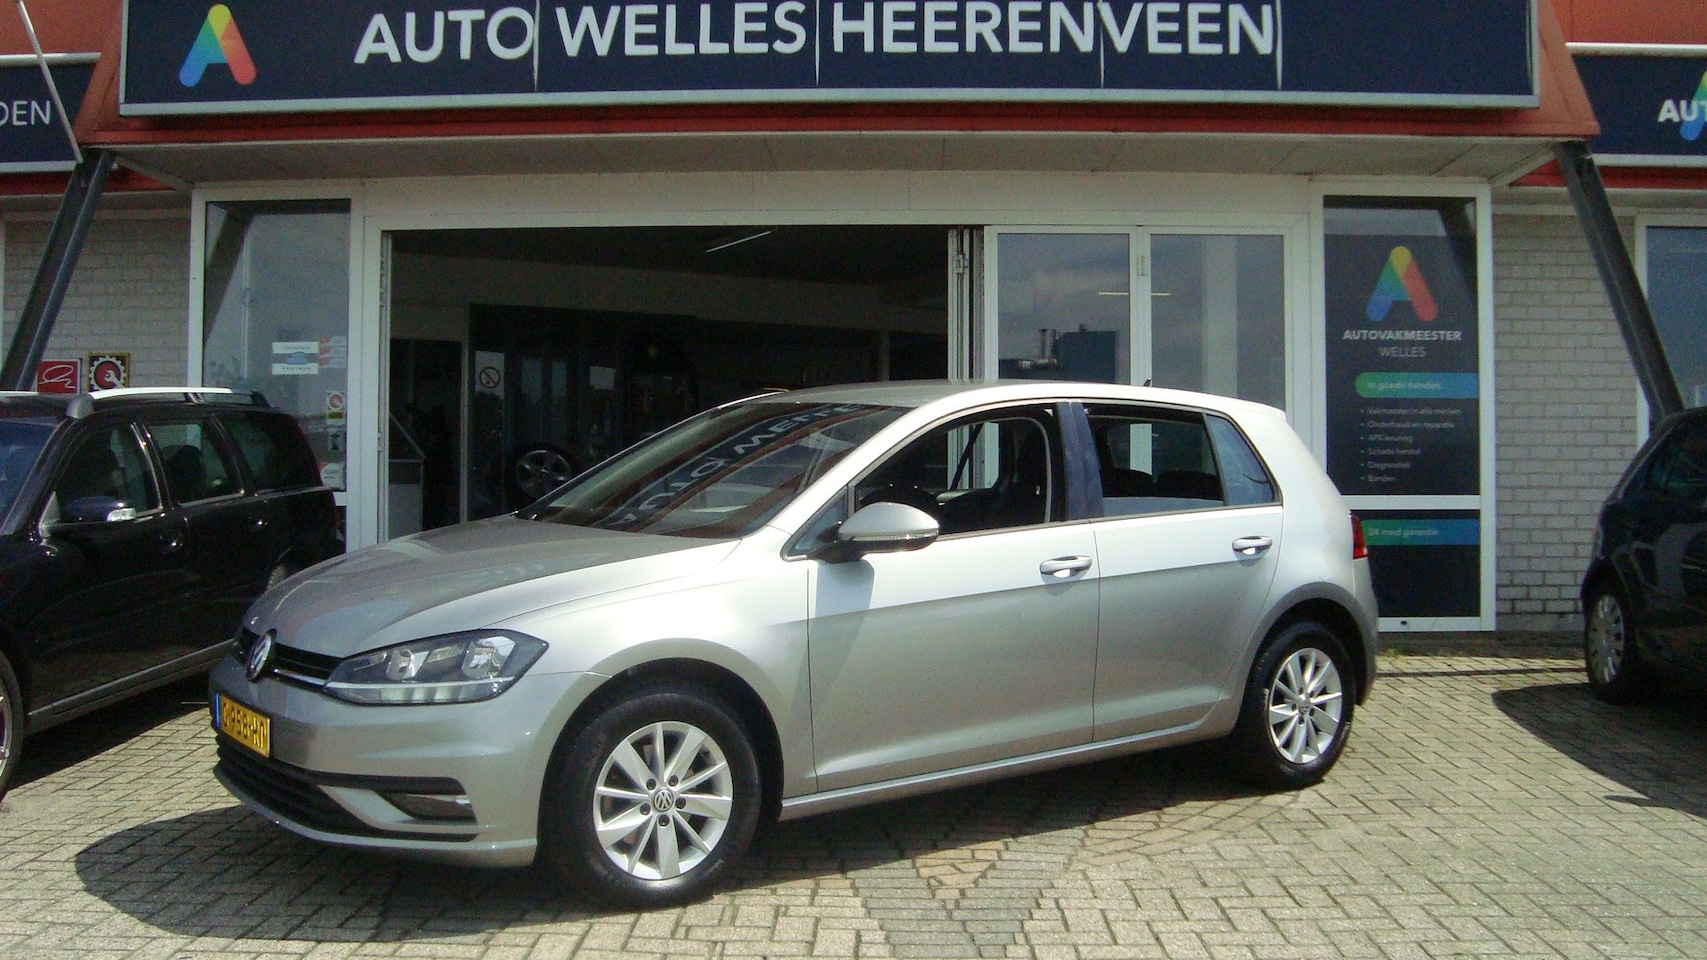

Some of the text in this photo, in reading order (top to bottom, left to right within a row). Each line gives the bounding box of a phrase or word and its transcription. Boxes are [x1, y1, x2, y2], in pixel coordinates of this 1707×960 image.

[353, 0, 1275, 64] AUTO WELLES HEERENVEEN
[1342, 329, 1462, 341] AUTOVAKMEESTER
[1379, 346, 1426, 357] WELLES
